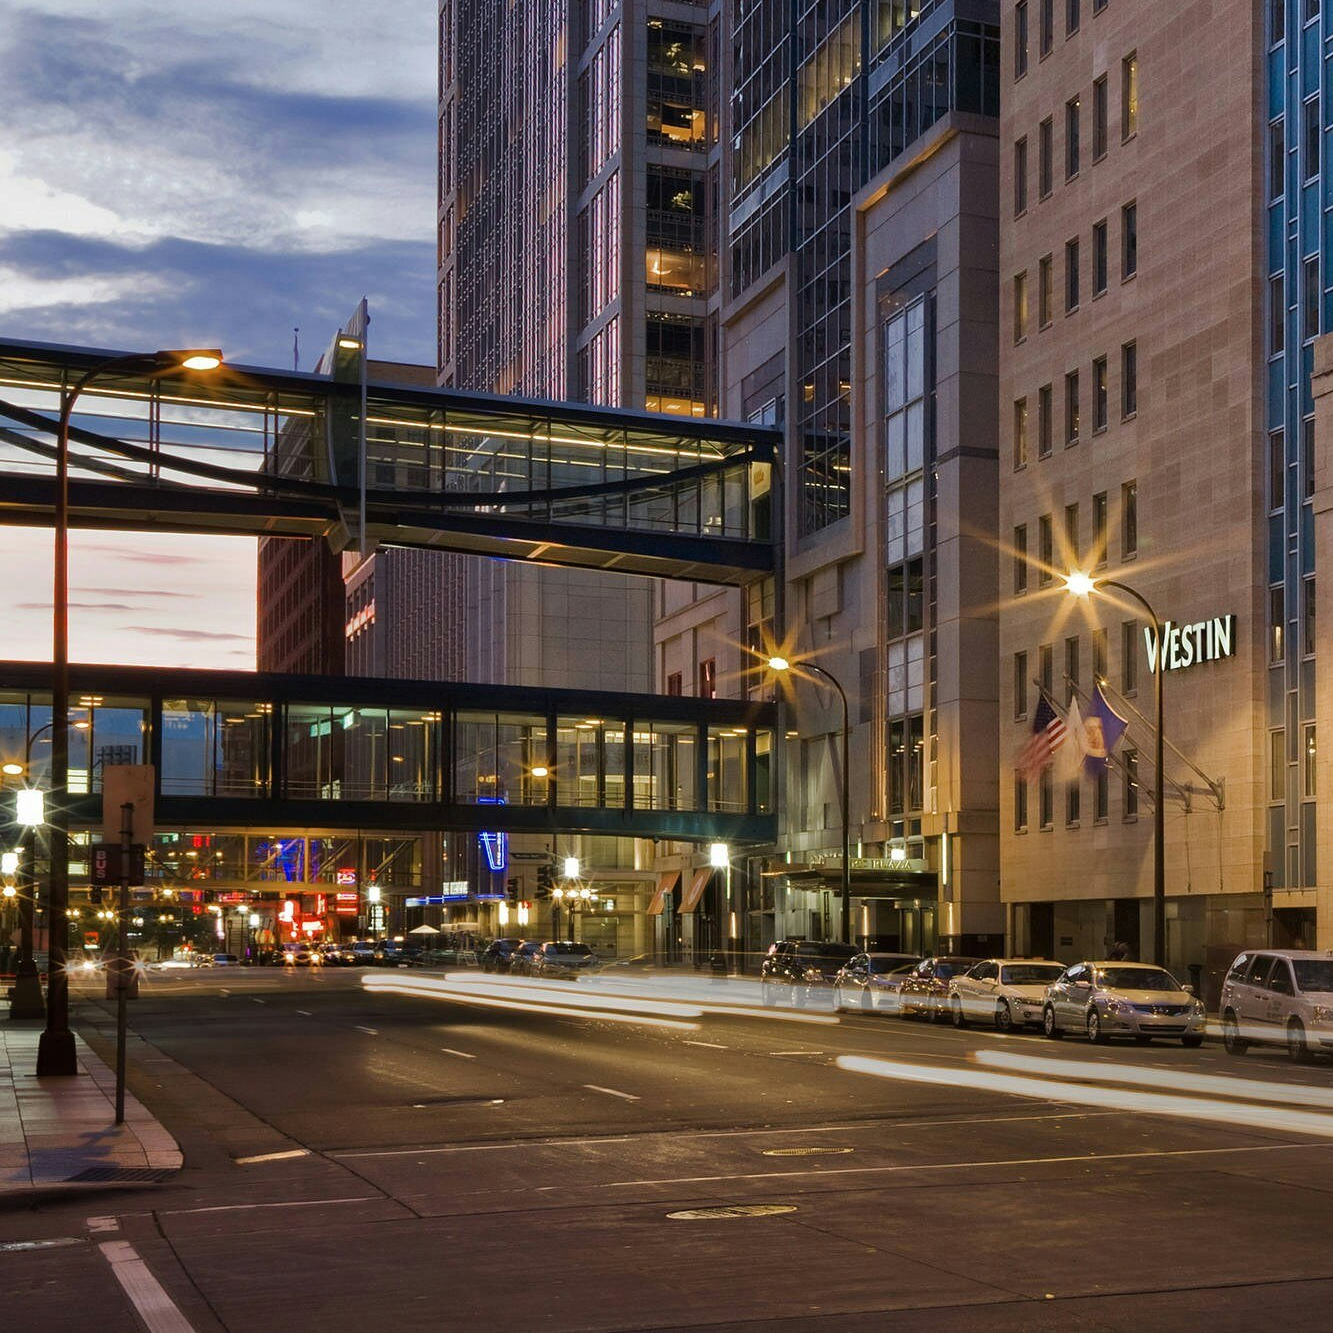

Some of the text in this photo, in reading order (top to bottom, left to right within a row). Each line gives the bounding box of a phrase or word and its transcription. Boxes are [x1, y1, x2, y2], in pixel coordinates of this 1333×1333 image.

[1144, 615, 1232, 674] WESTIN
[95, 850, 106, 878] BUS
[871, 859, 912, 870] PLAZA
